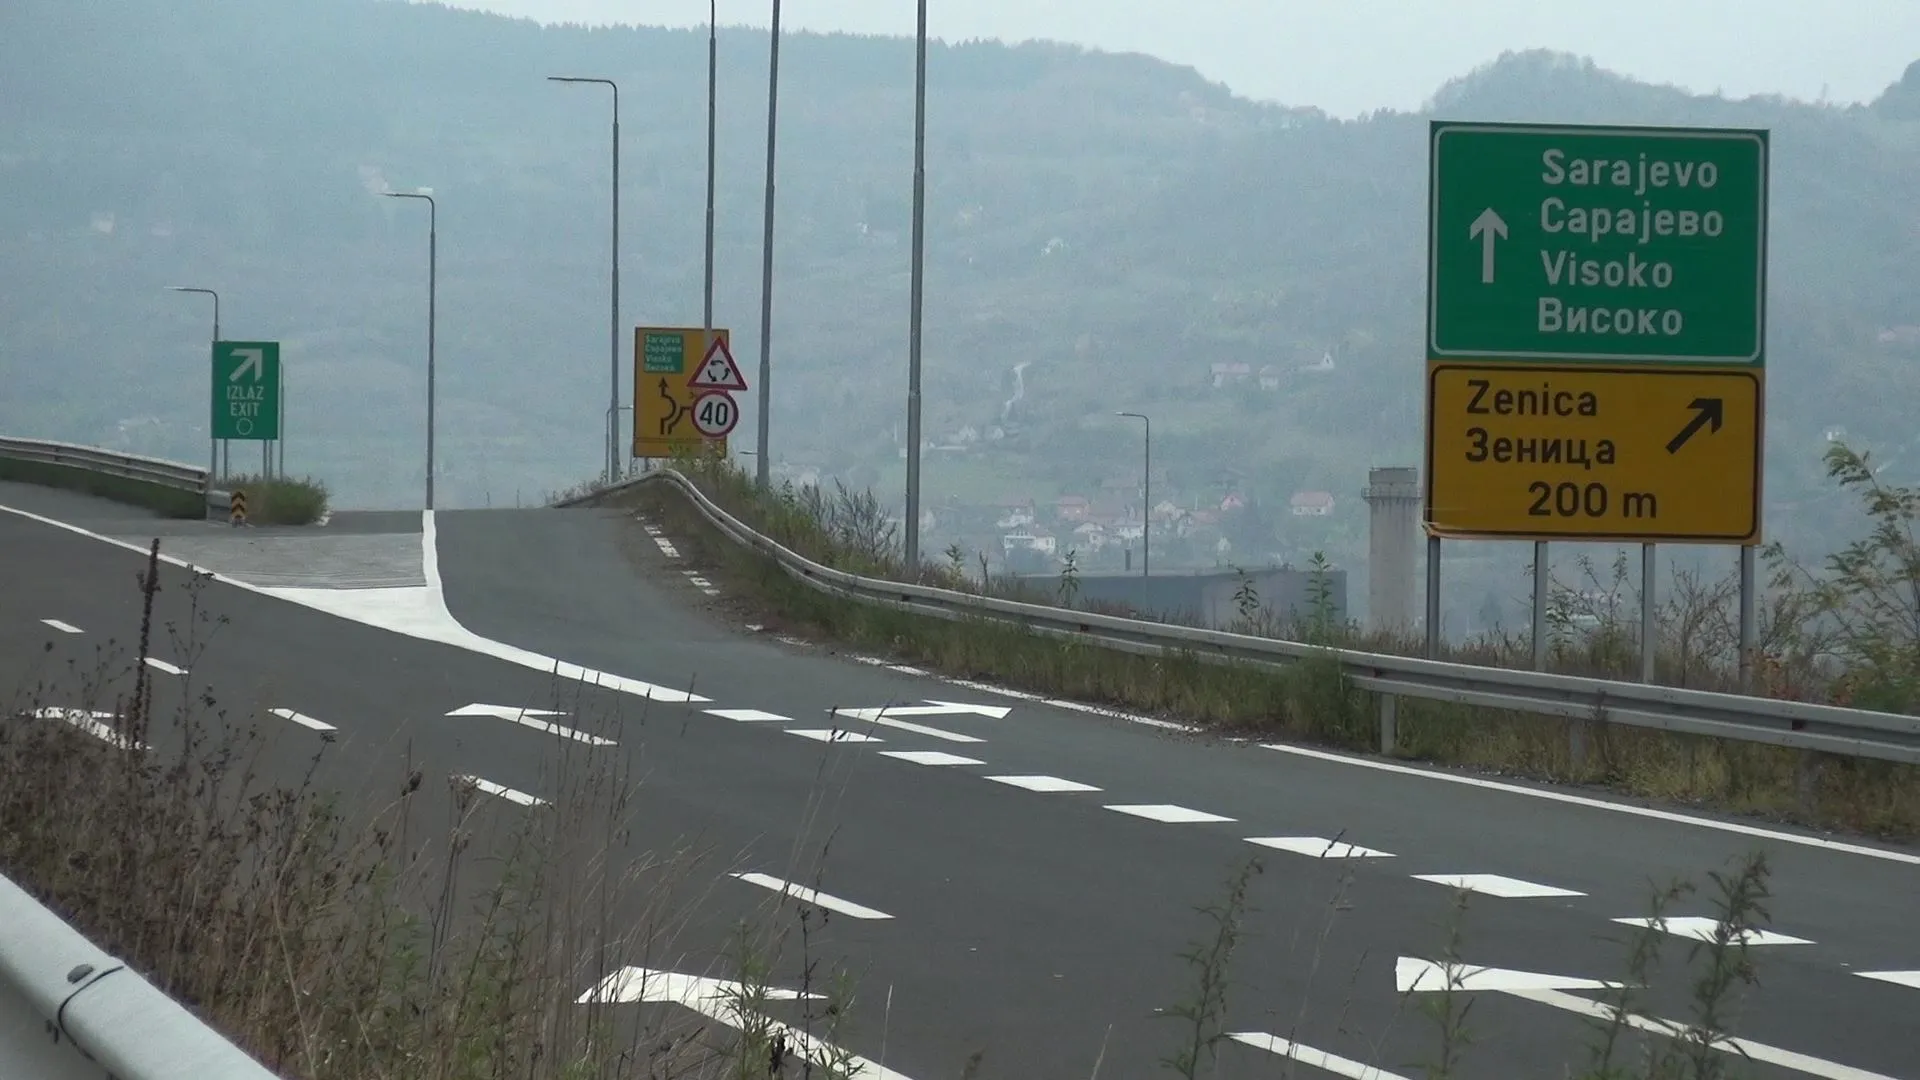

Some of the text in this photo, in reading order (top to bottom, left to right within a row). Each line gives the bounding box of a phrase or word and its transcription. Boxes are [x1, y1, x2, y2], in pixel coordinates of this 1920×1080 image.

[1542, 149, 1718, 195] Sarajevo
[1540, 197, 1723, 244] Сарајево
[1540, 250, 1673, 288] Visoko
[1538, 297, 1683, 335] Високо
[227, 385, 264, 400] IZLAZ
[230, 402, 260, 416] EXIT
[1466, 379, 1597, 417] Zenica
[700, 401, 728, 426] 40
[1465, 427, 1615, 470] Зеница
[1528, 481, 1657, 518] 200 m
